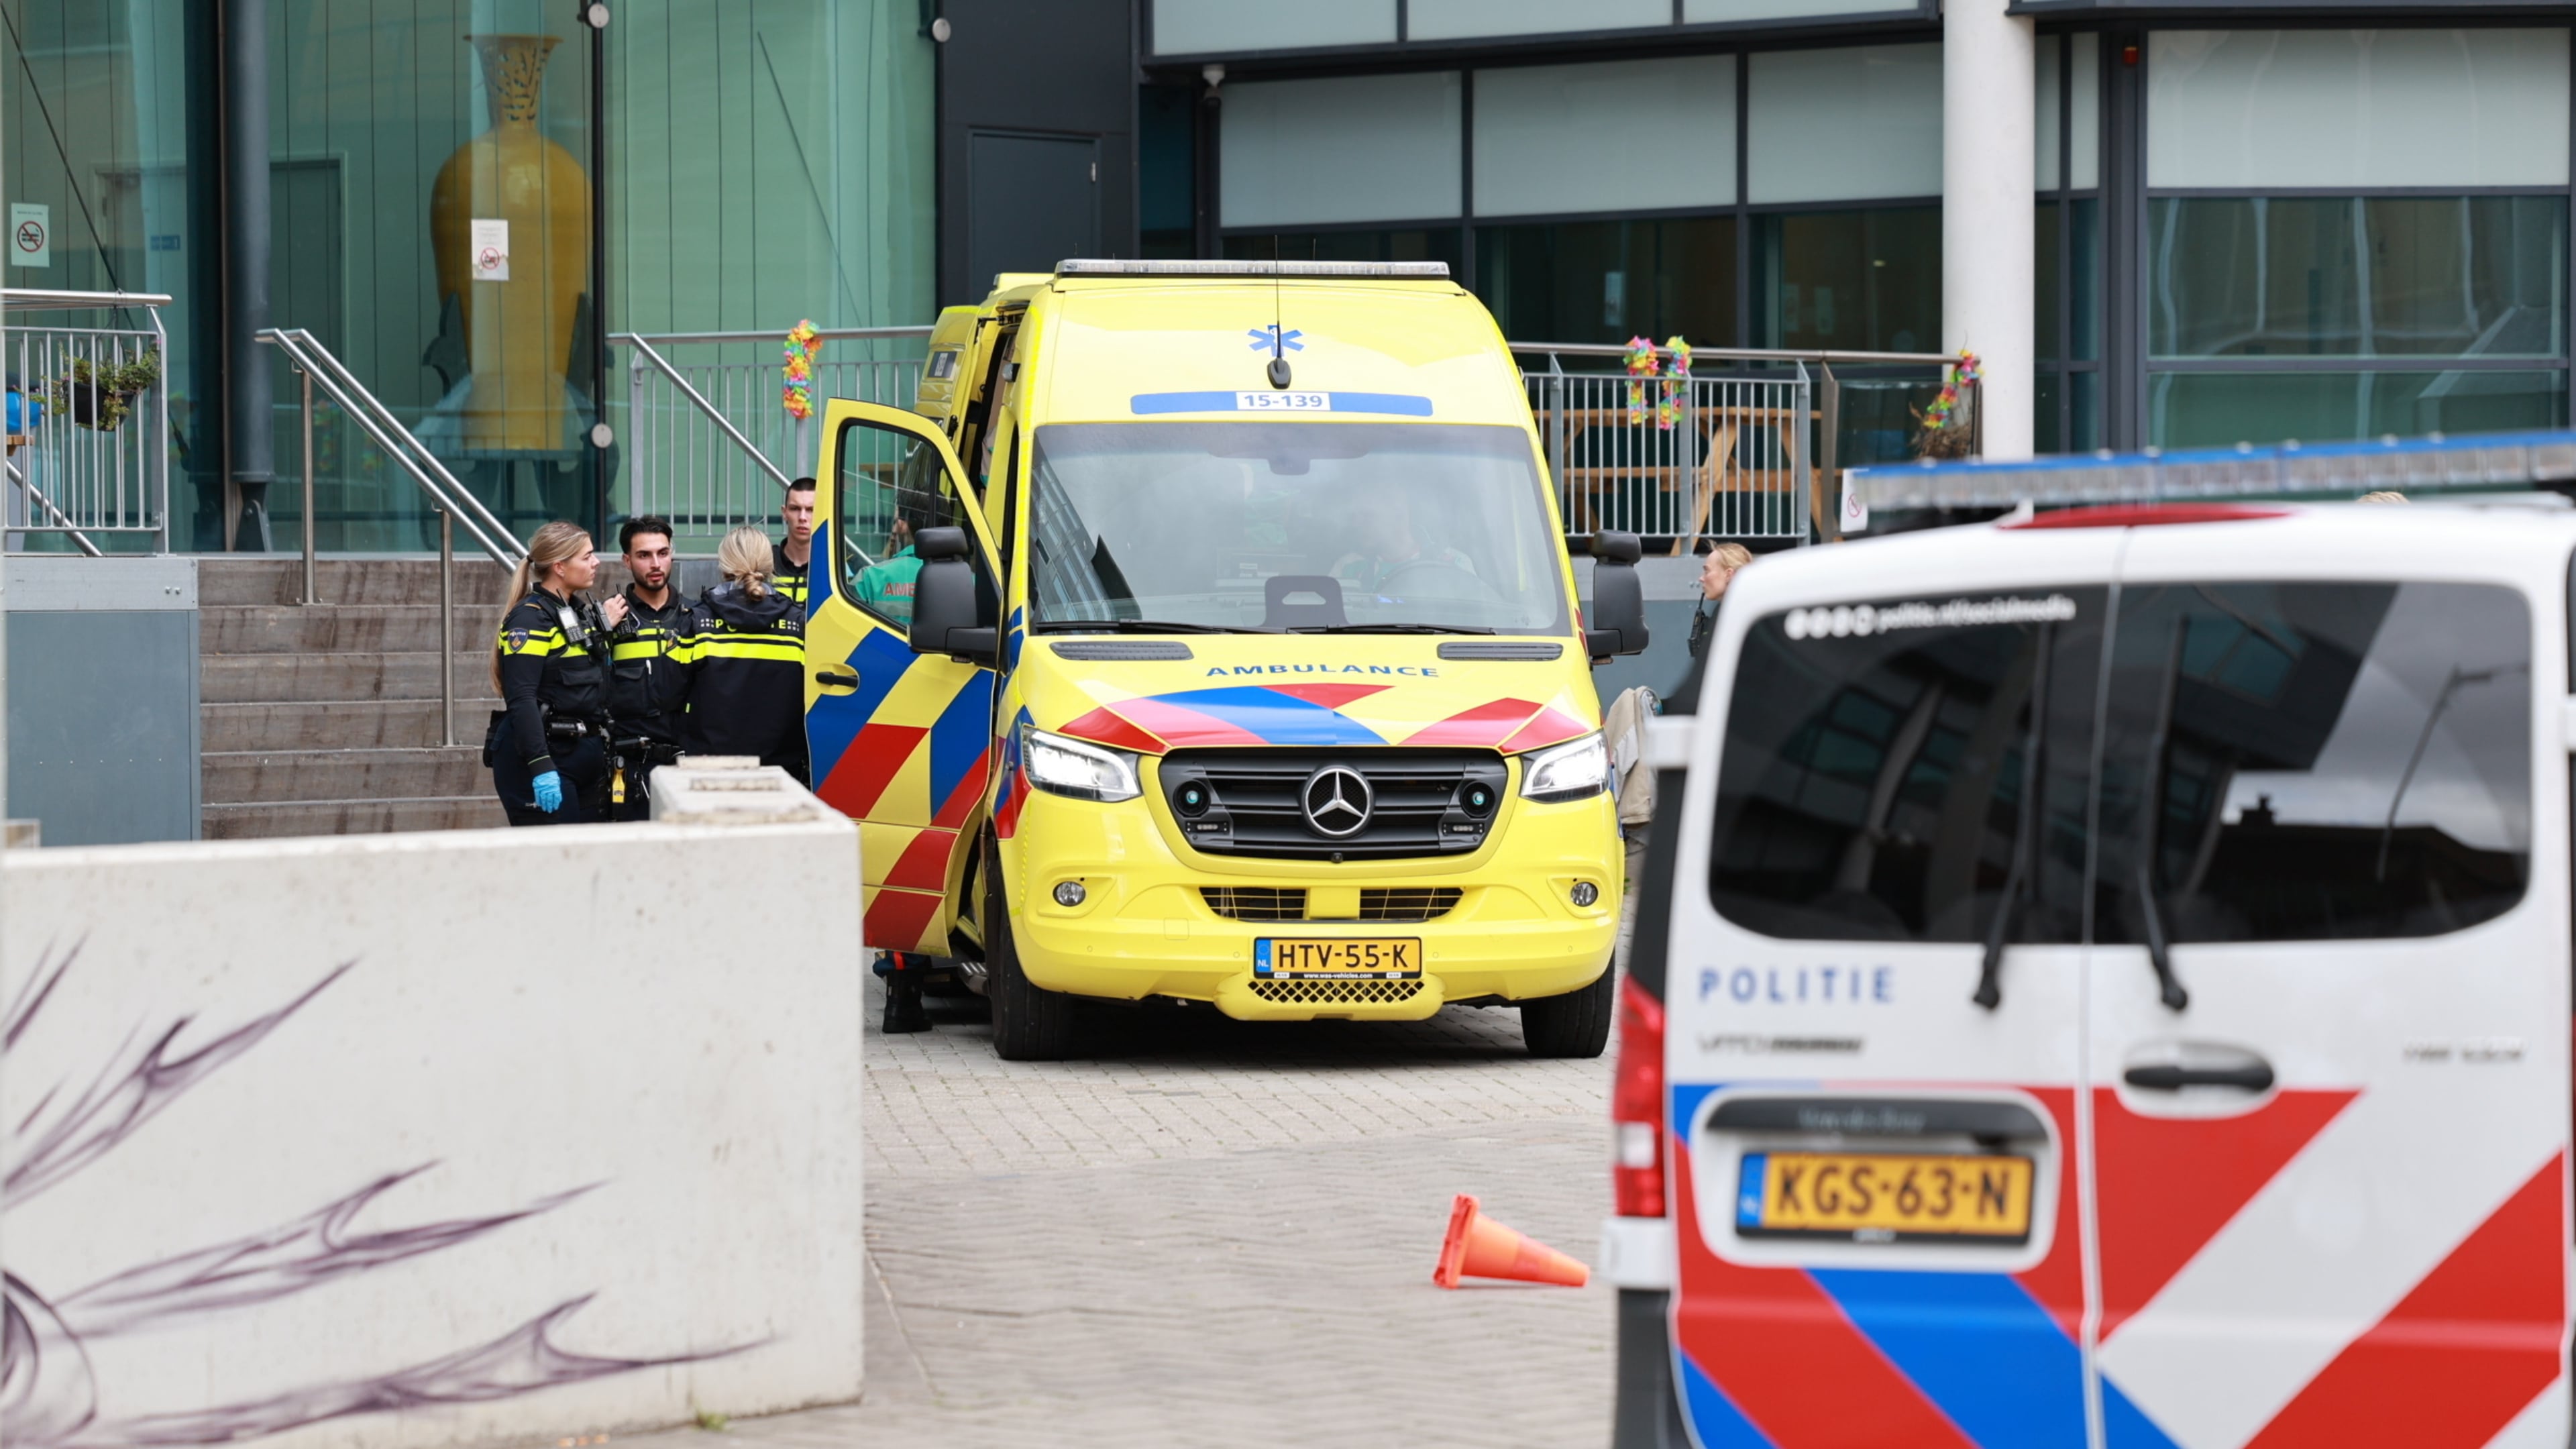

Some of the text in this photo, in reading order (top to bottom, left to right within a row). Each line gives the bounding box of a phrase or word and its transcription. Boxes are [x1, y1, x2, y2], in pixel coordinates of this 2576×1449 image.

[1244, 394, 1323, 408] 15-139
[1205, 664, 1440, 678] AMBULANCE
[1257, 959, 1269, 967] NL
[1279, 944, 1409, 968] HTV-55-K
[1699, 966, 1897, 1003] POLITIE
[1776, 1163, 2012, 1221] KGS-63-N
